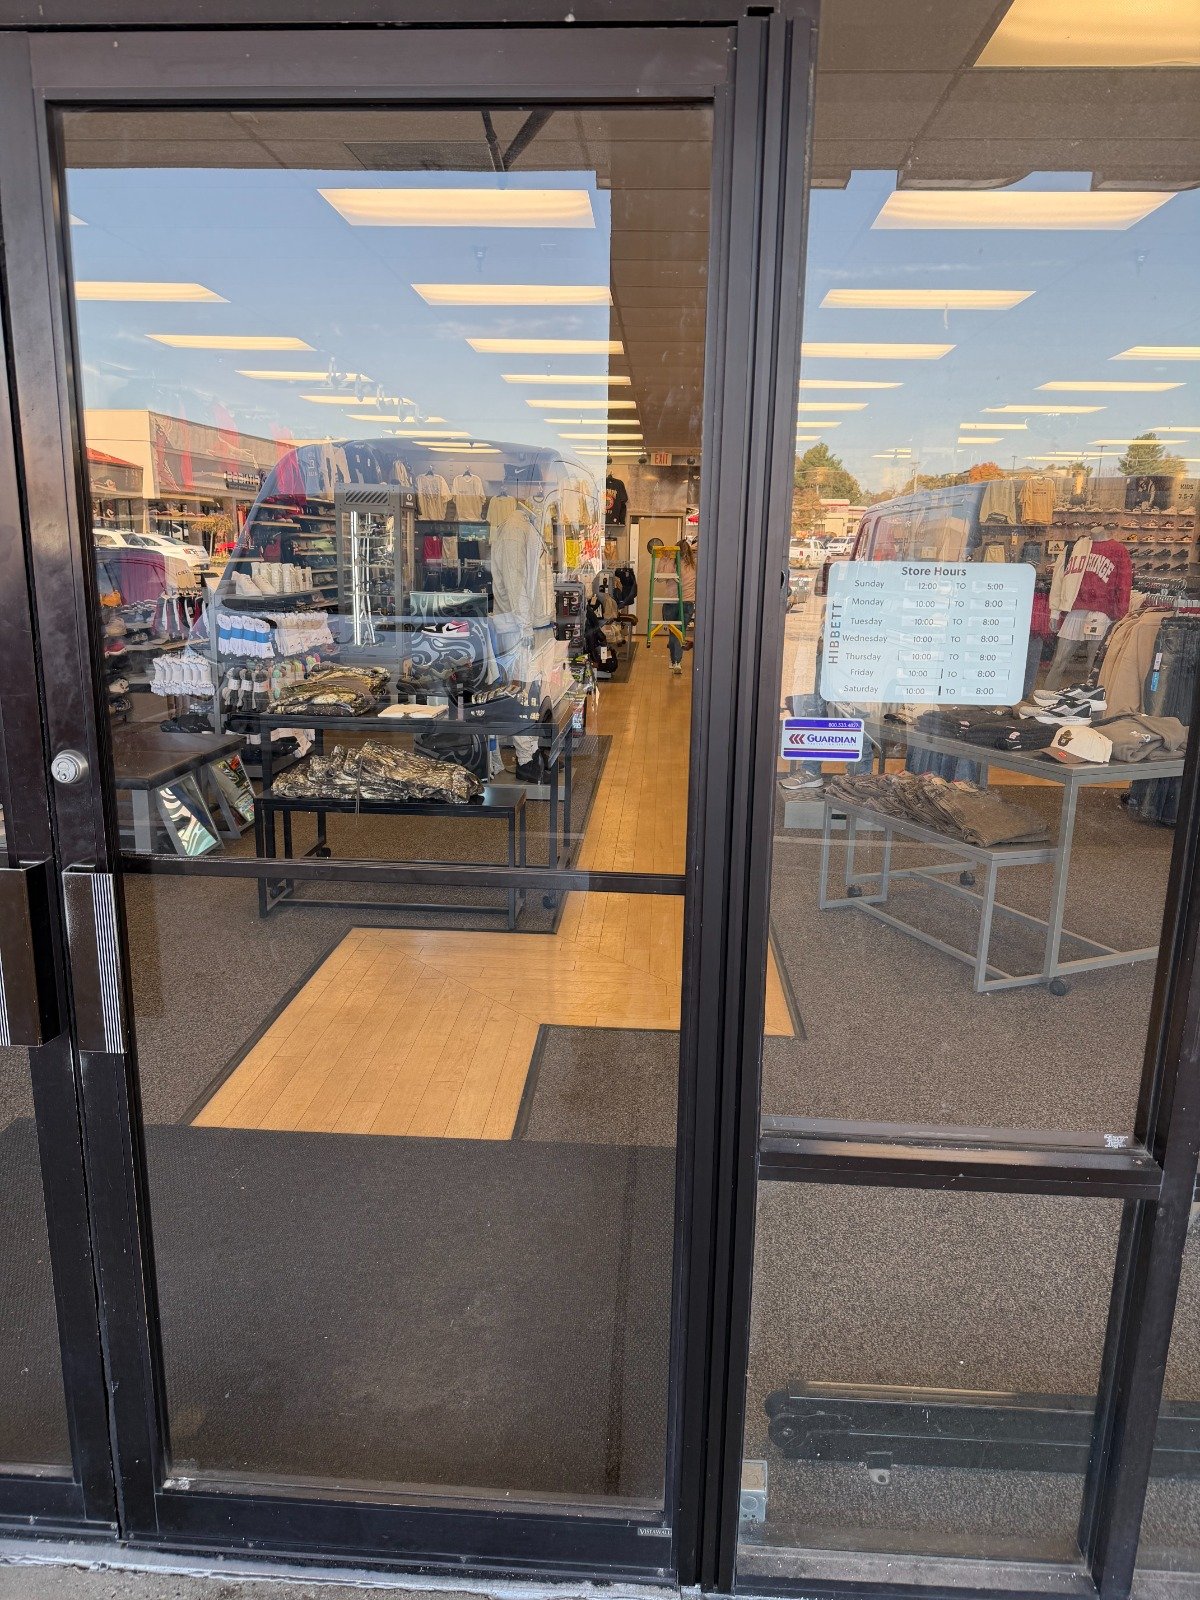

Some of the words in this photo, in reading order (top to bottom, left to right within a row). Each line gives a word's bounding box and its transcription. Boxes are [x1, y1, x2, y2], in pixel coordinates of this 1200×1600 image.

[655, 453, 668, 464] EXIT
[901, 566, 931, 576] Store
[934, 566, 967, 576] Hours
[854, 579, 885, 589] Sunday
[918, 582, 938, 590] 12:00
[956, 582, 967, 590] TO
[987, 583, 1004, 591] 5:00
[851, 597, 885, 606] Monday
[916, 600, 936, 608] 10:00
[954, 600, 965, 608] TO
[984, 600, 1003, 608] 8:00
[850, 617, 883, 627] Tuesday
[914, 618, 934, 626] 10:00
[952, 618, 963, 626] TO
[982, 618, 1000, 626] 8:00
[828, 602, 843, 664] HIBBETT
[842, 634, 888, 644] Wednesday
[913, 635, 933, 643] 10:00
[950, 635, 961, 643] TO
[980, 635, 999, 643] 8:00
[845, 652, 882, 662] Thursday
[912, 653, 932, 661] 10:00
[949, 653, 960, 661] TO
[979, 654, 997, 662] 8:00
[850, 668, 874, 678] Friday
[908, 669, 928, 678] 10:00
[947, 670, 958, 678] TO
[977, 670, 996, 678] 8:00
[843, 684, 879, 694] Saturday
[906, 687, 925, 695] 10:00
[975, 687, 994, 695] 8:00
[806, 733, 857, 744] GUARDIAN
